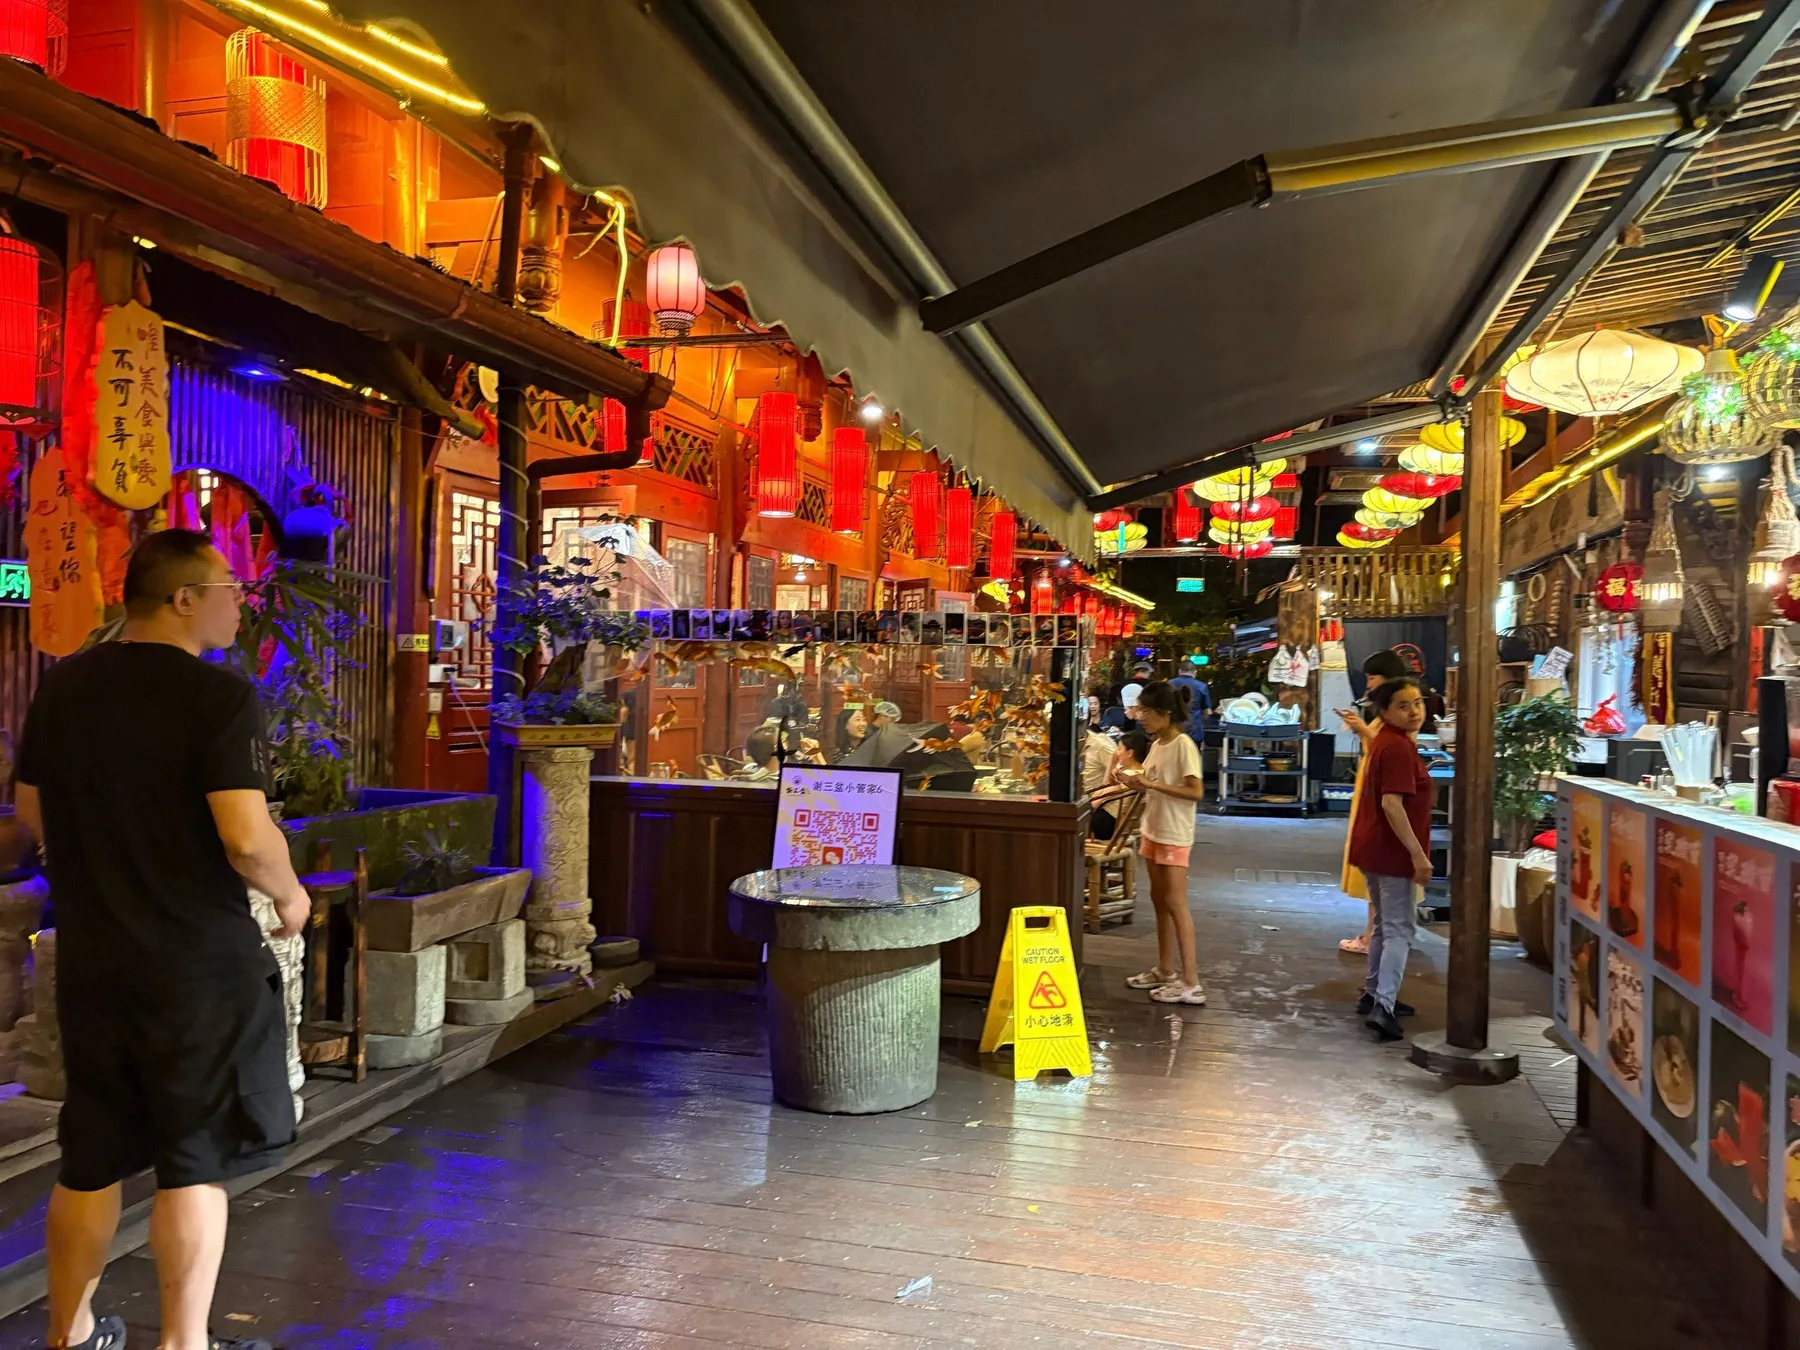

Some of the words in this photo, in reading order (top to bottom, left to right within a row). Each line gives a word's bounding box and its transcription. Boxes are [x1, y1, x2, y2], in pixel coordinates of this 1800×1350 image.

[1026, 948, 1060, 956] CAUTION
[1040, 956, 1065, 964] FLOOR
[1025, 1014, 1073, 1028] 小心地滑
